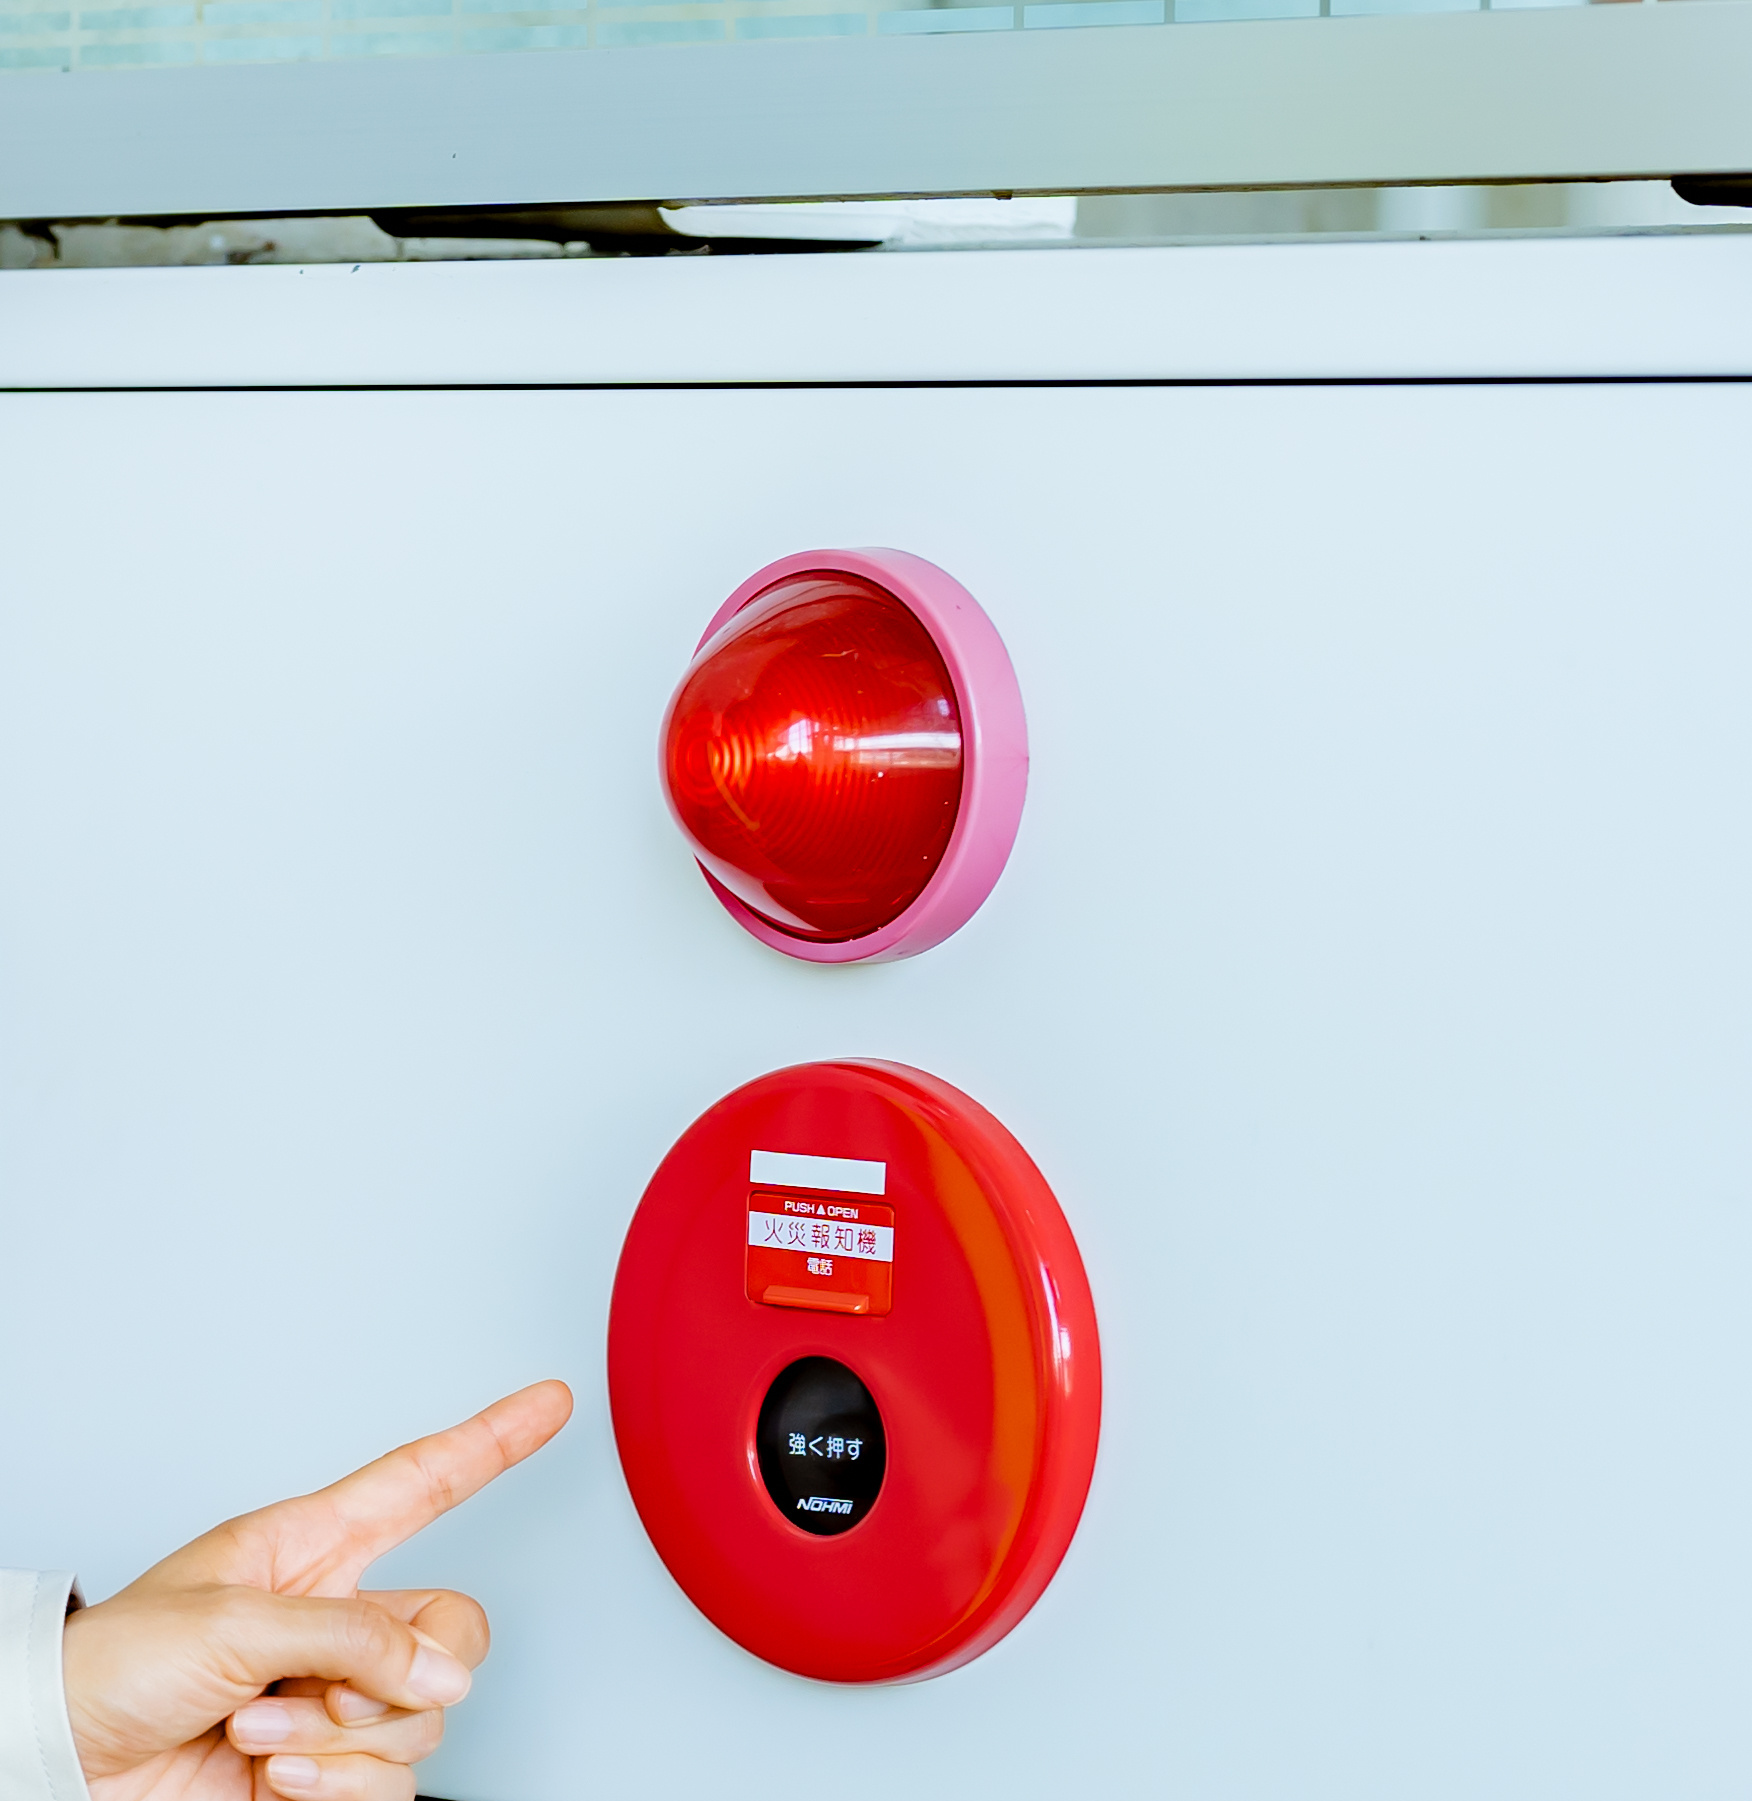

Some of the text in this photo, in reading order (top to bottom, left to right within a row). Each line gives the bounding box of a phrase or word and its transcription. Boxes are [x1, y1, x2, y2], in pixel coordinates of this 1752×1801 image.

[785, 1201, 858, 1218] PUSH OPEN
[765, 1218, 876, 1254] 火災報知機
[808, 1258, 833, 1275] 電話
[788, 1432, 863, 1460] 強く押す
[797, 1497, 853, 1514] NOHMI
